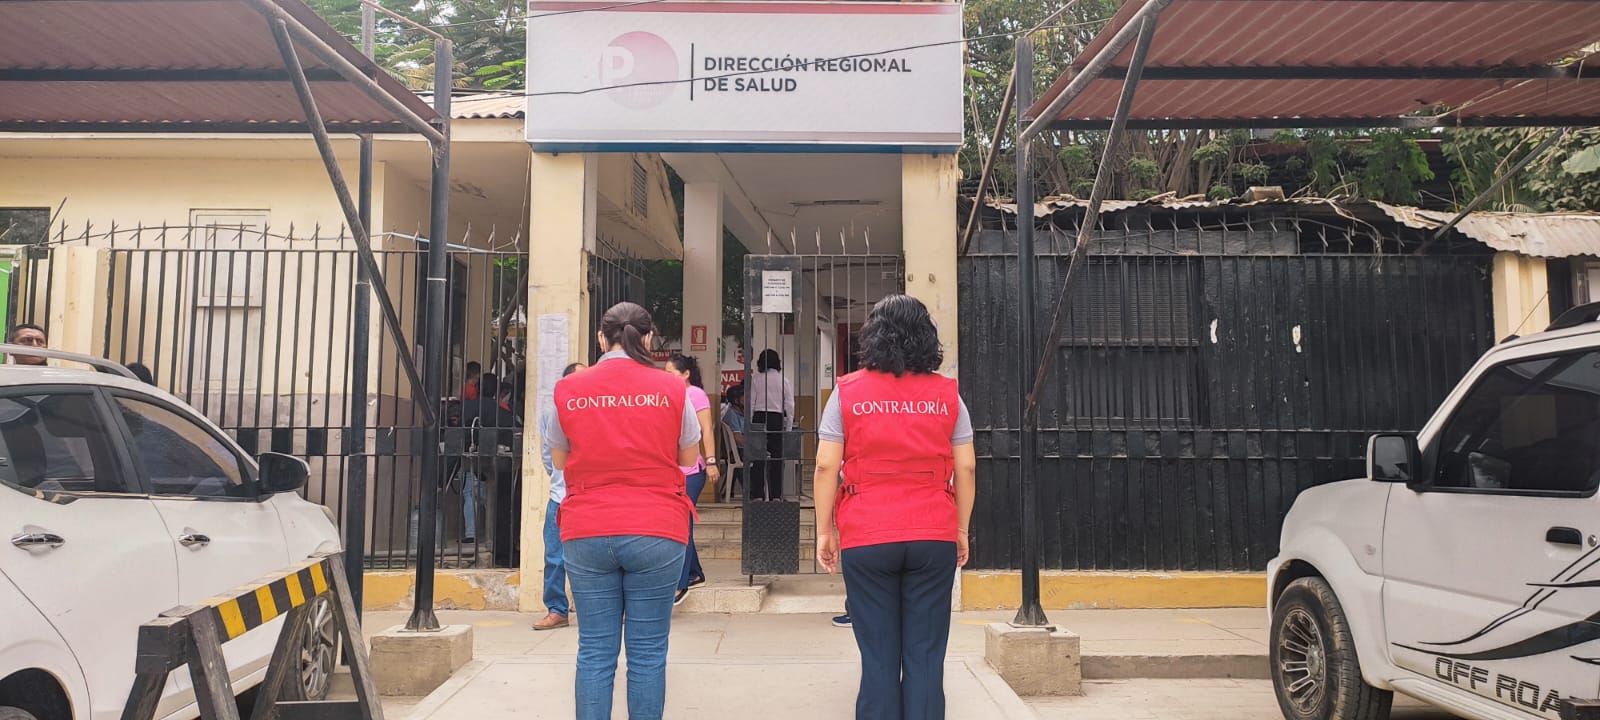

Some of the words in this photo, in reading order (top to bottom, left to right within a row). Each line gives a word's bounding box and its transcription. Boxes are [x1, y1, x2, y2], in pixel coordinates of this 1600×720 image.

[704, 54, 808, 72] DIRECCIÓN
[814, 58, 912, 73] REGIONAL
[704, 77, 729, 92] DE
[734, 77, 798, 92] SALUD
[566, 391, 670, 411] CONTRALORÍA
[852, 397, 949, 416] CONTRALORÍA
[1435, 656, 1489, 690] OFF
[1495, 673, 1563, 713] ROA
